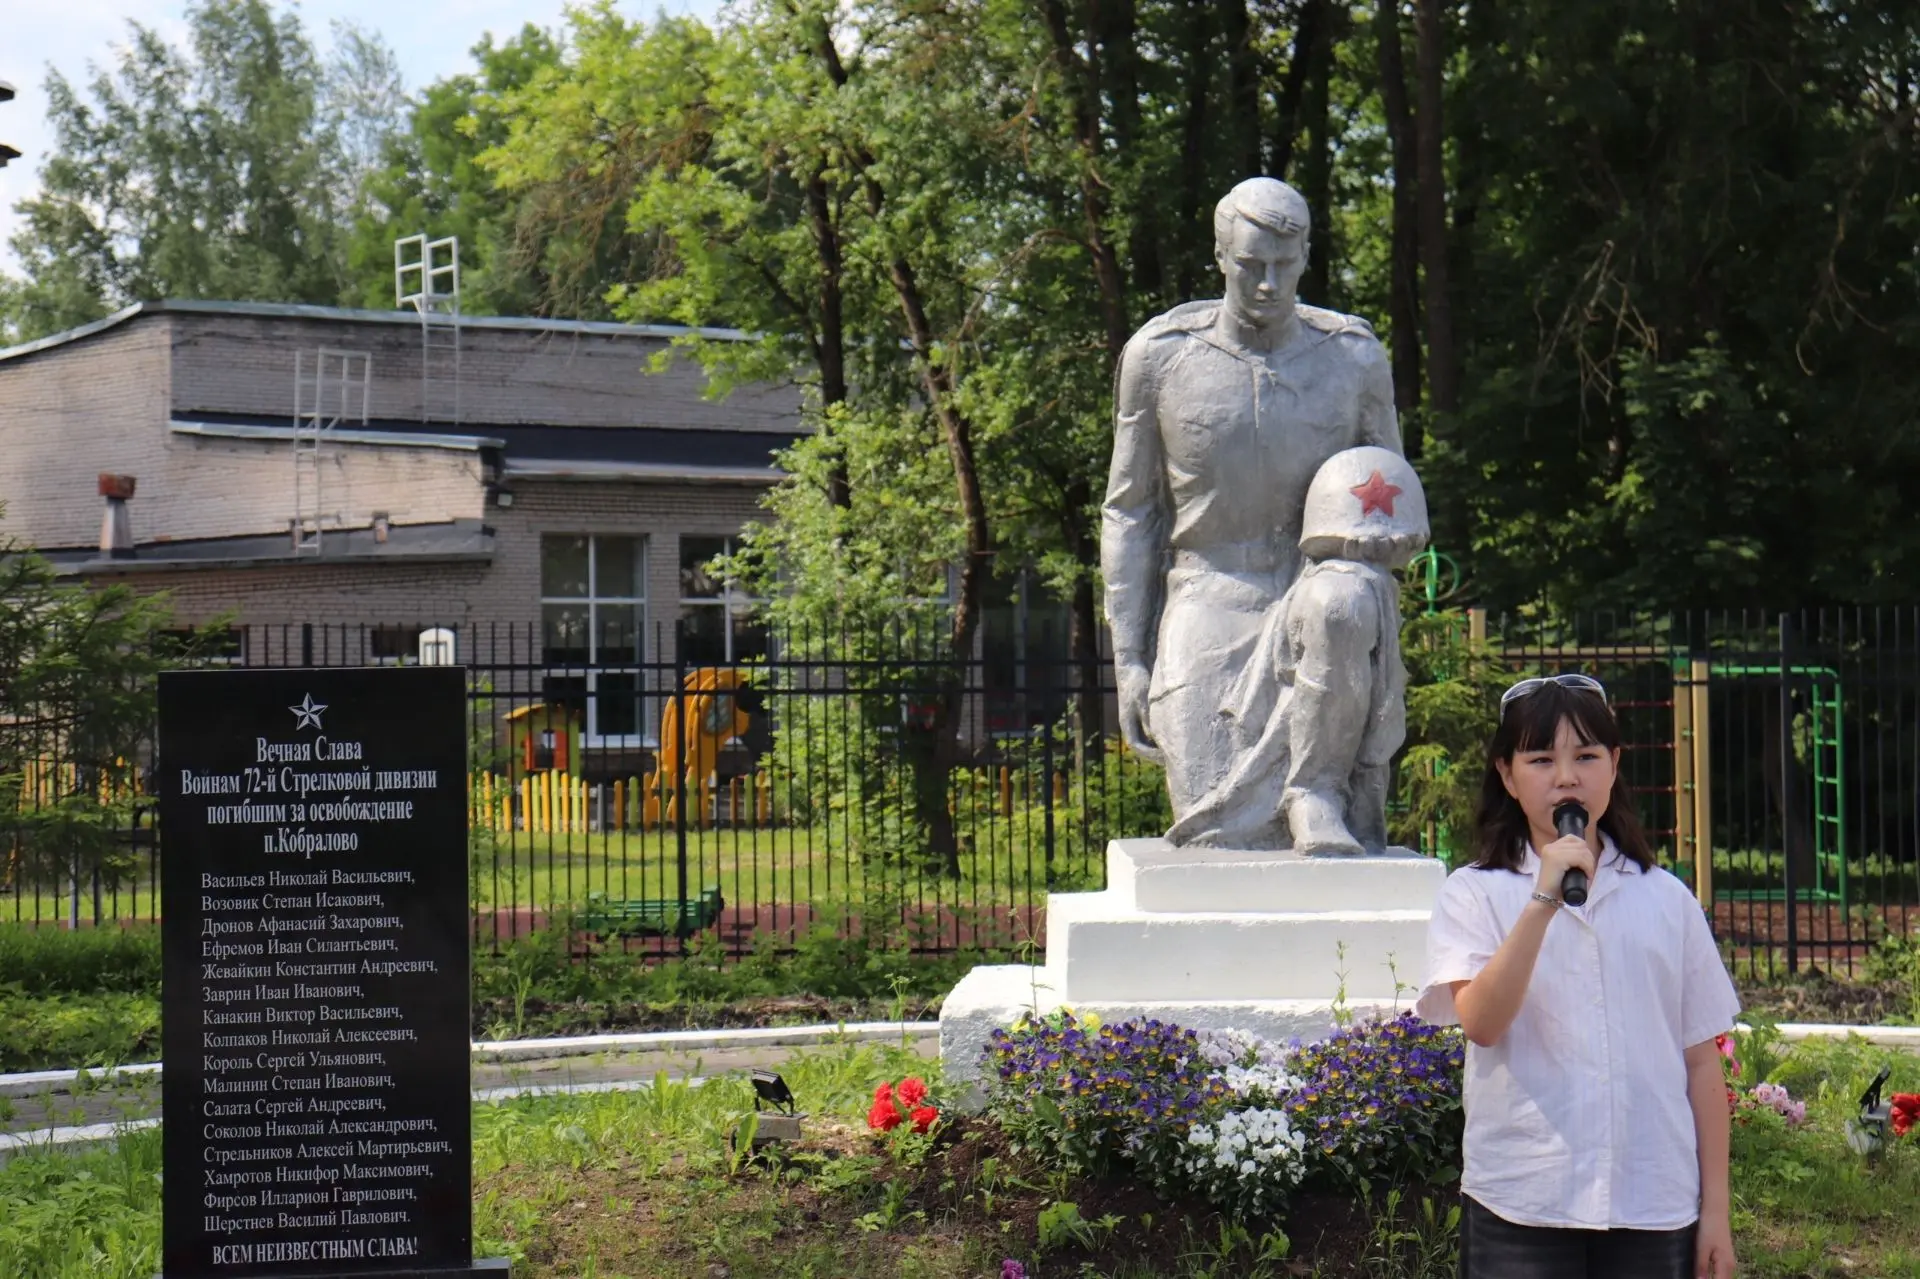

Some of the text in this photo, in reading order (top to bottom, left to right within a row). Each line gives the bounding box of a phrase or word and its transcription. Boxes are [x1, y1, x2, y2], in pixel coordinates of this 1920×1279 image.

[256, 735, 362, 763] Вечная Слава
[244, 767, 277, 793] 72-й
[280, 765, 371, 799] Стрелковой
[374, 770, 437, 792] дивизии
[207, 795, 413, 825] погибшим за освобождение
[264, 826, 358, 859] п.Кобралово
[201, 869, 416, 889] Васильев Николай Васильевич,
[262, 893, 312, 909] Степан
[316, 891, 385, 908] Исакович,
[201, 914, 404, 937] Дронов Афанасий Захарович,
[202, 937, 399, 960] Ефремов Иван Силантьевич,
[276, 961, 356, 977] Константин
[360, 959, 438, 977] Андреевич,
[255, 984, 290, 1000] Иван
[294, 983, 365, 999] Иванович,
[266, 1007, 316, 1026] Виктор
[319, 1005, 403, 1021] Васильевич,
[203, 1027, 418, 1048] Колпаков Николай Алексеевич,
[203, 1050, 386, 1074] Король Сергей Ульянович,
[203, 1073, 396, 1094] Малинин Степан Иванович,
[203, 1097, 387, 1118] Салата Сергей Андреевич,
[203, 1119, 438, 1140] Соколов Николай Александрович,
[203, 1146, 293, 1165] Стрельников
[297, 1141, 353, 1158] Алексей
[276, 1164, 339, 1185] Никифор
[343, 1163, 434, 1180] Максимович,
[203, 1186, 417, 1211] Фирсов Илларион Гаврилович,
[203, 1209, 411, 1234] Шерстнев Василий Павлович.
[212, 1236, 419, 1265] ВСЕМ НЕИЗВЕСТНЫМ СЛАВА!
